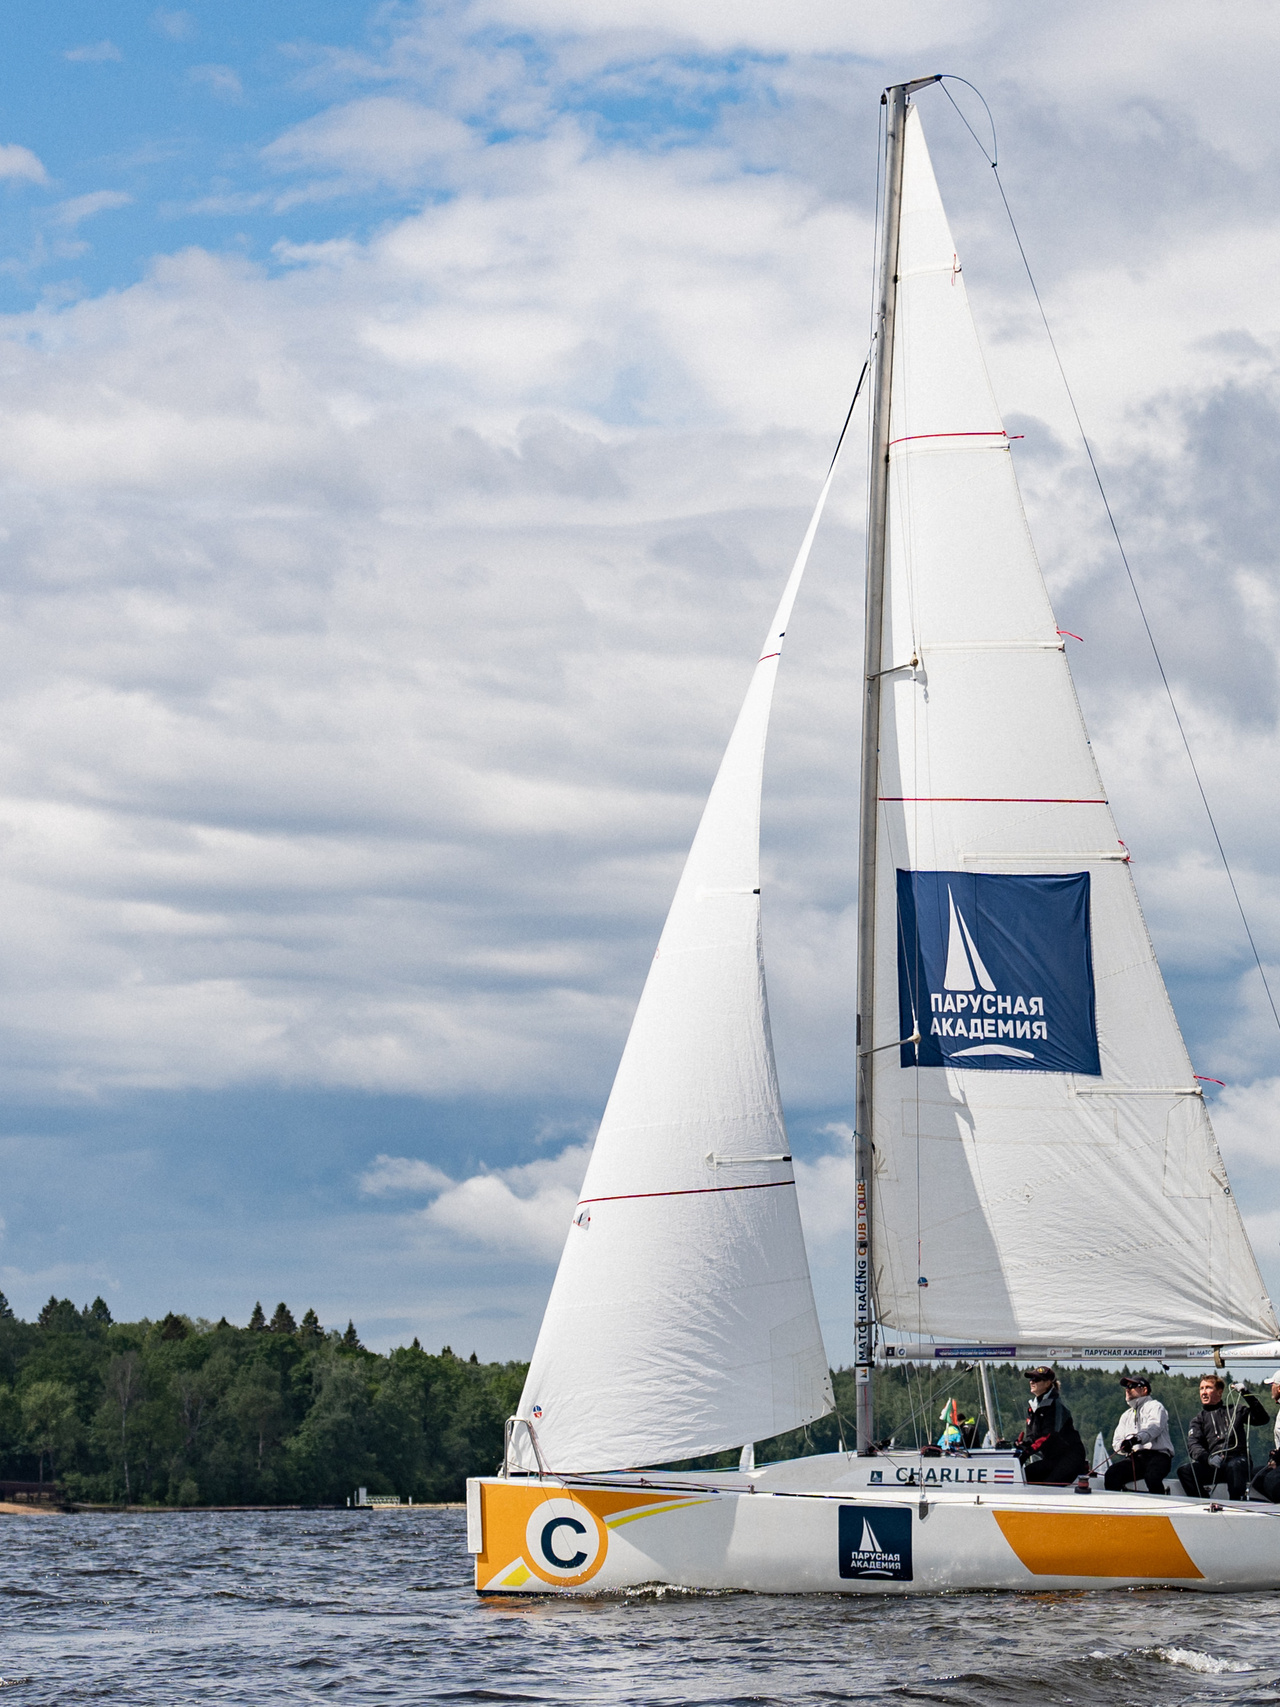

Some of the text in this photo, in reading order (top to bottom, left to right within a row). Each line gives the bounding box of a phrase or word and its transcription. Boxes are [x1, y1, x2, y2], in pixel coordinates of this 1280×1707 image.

[931, 993, 1044, 1016] ПАРУСНАЯ
[930, 1017, 1047, 1040] АКАДЕМИЯ
[857, 1183, 867, 1361] MATCH RACING CUB TOUR
[896, 1467, 988, 1484] CHARLIE
[541, 1517, 588, 1569] C
[850, 1560, 901, 1570] АКАДЕМИЯ
[851, 1552, 900, 1561] ПАРУСНАЯ
